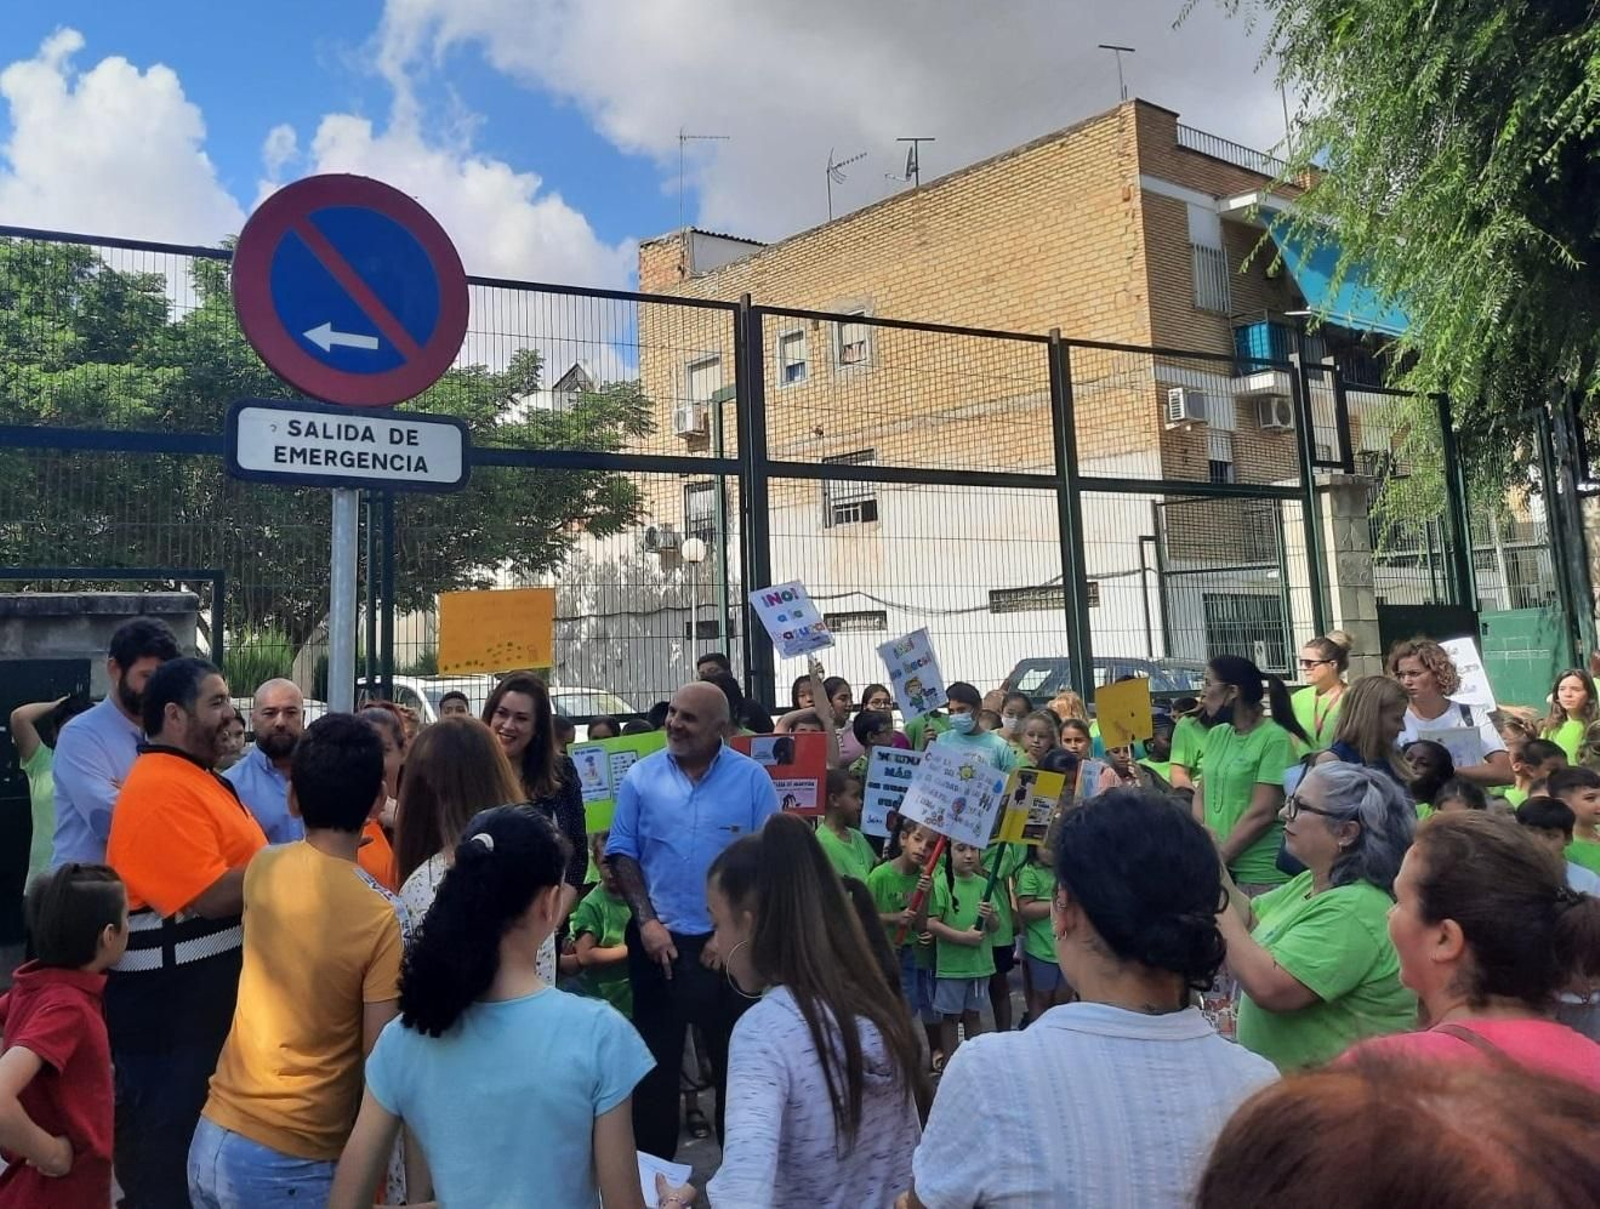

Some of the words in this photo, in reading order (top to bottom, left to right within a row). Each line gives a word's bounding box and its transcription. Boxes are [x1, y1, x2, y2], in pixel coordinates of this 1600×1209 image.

[287, 419, 376, 443] SALIDA
[388, 427, 419, 446] DE
[273, 446, 428, 473] EMERGENCIA
